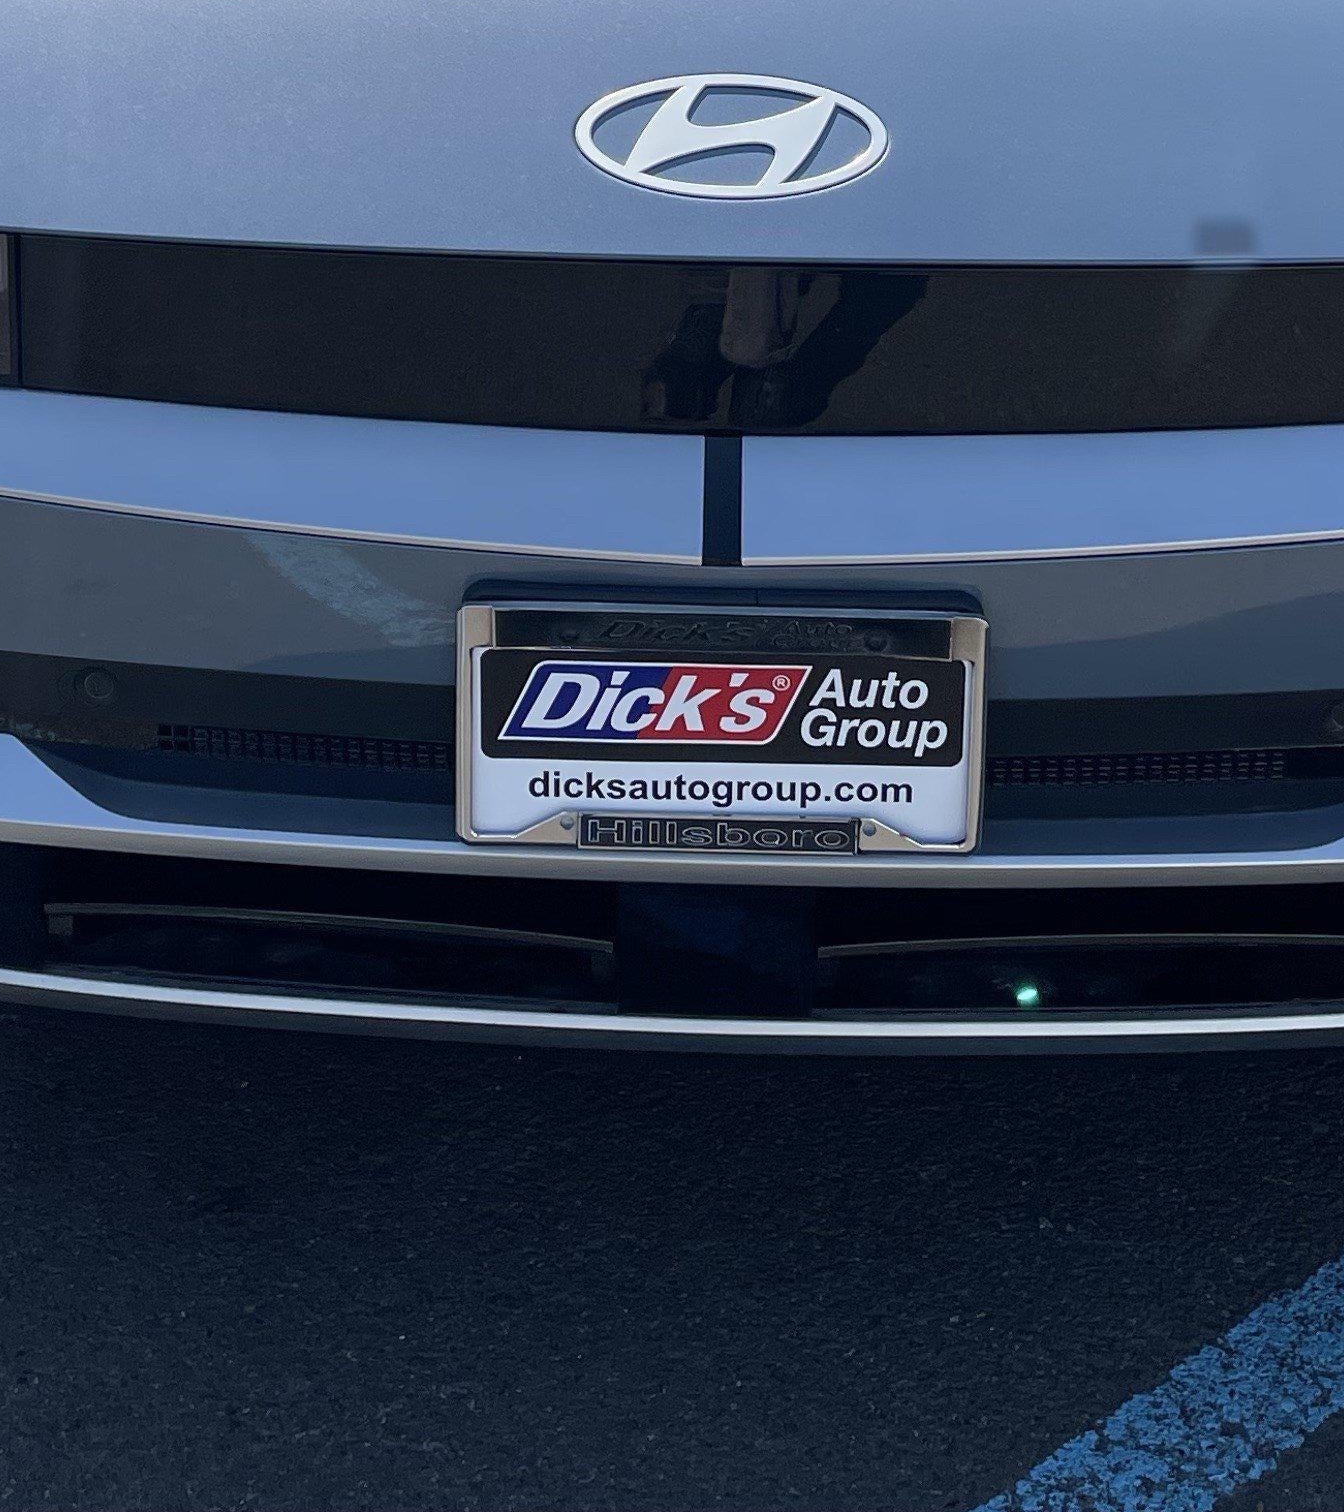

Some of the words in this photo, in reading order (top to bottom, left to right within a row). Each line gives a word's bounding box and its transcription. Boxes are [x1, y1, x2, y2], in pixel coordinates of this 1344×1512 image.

[808, 668, 929, 710] Auto
[800, 707, 948, 757] Group
[527, 770, 914, 807] dicksautogroup.com
[587, 818, 851, 849] Hillsboro
